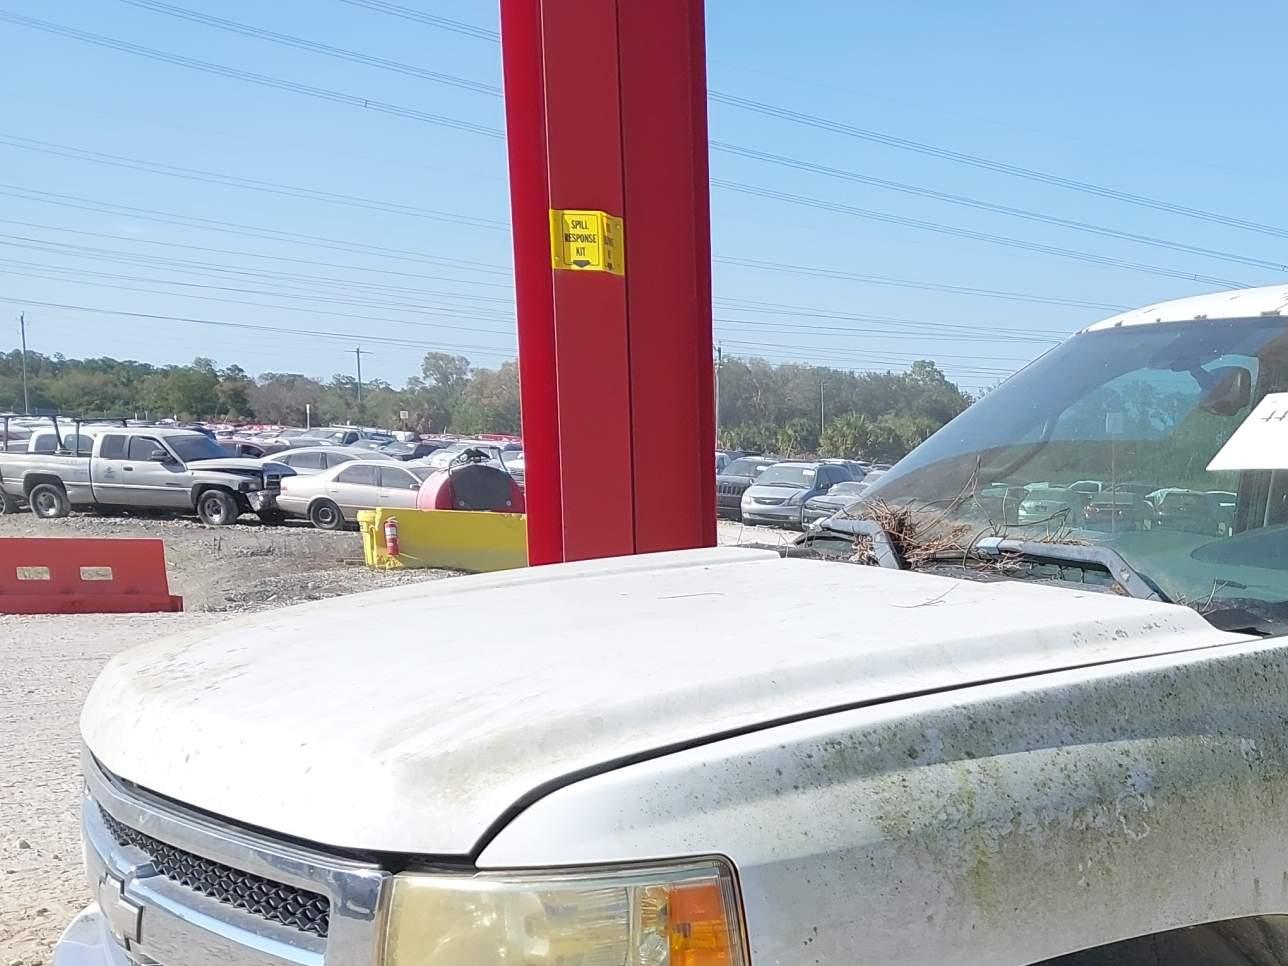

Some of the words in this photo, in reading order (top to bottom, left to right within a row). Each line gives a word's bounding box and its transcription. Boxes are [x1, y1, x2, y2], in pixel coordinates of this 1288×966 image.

[571, 219, 589, 230] SPILL
[564, 233, 597, 244] RESPONSE
[575, 246, 586, 257] KIT
